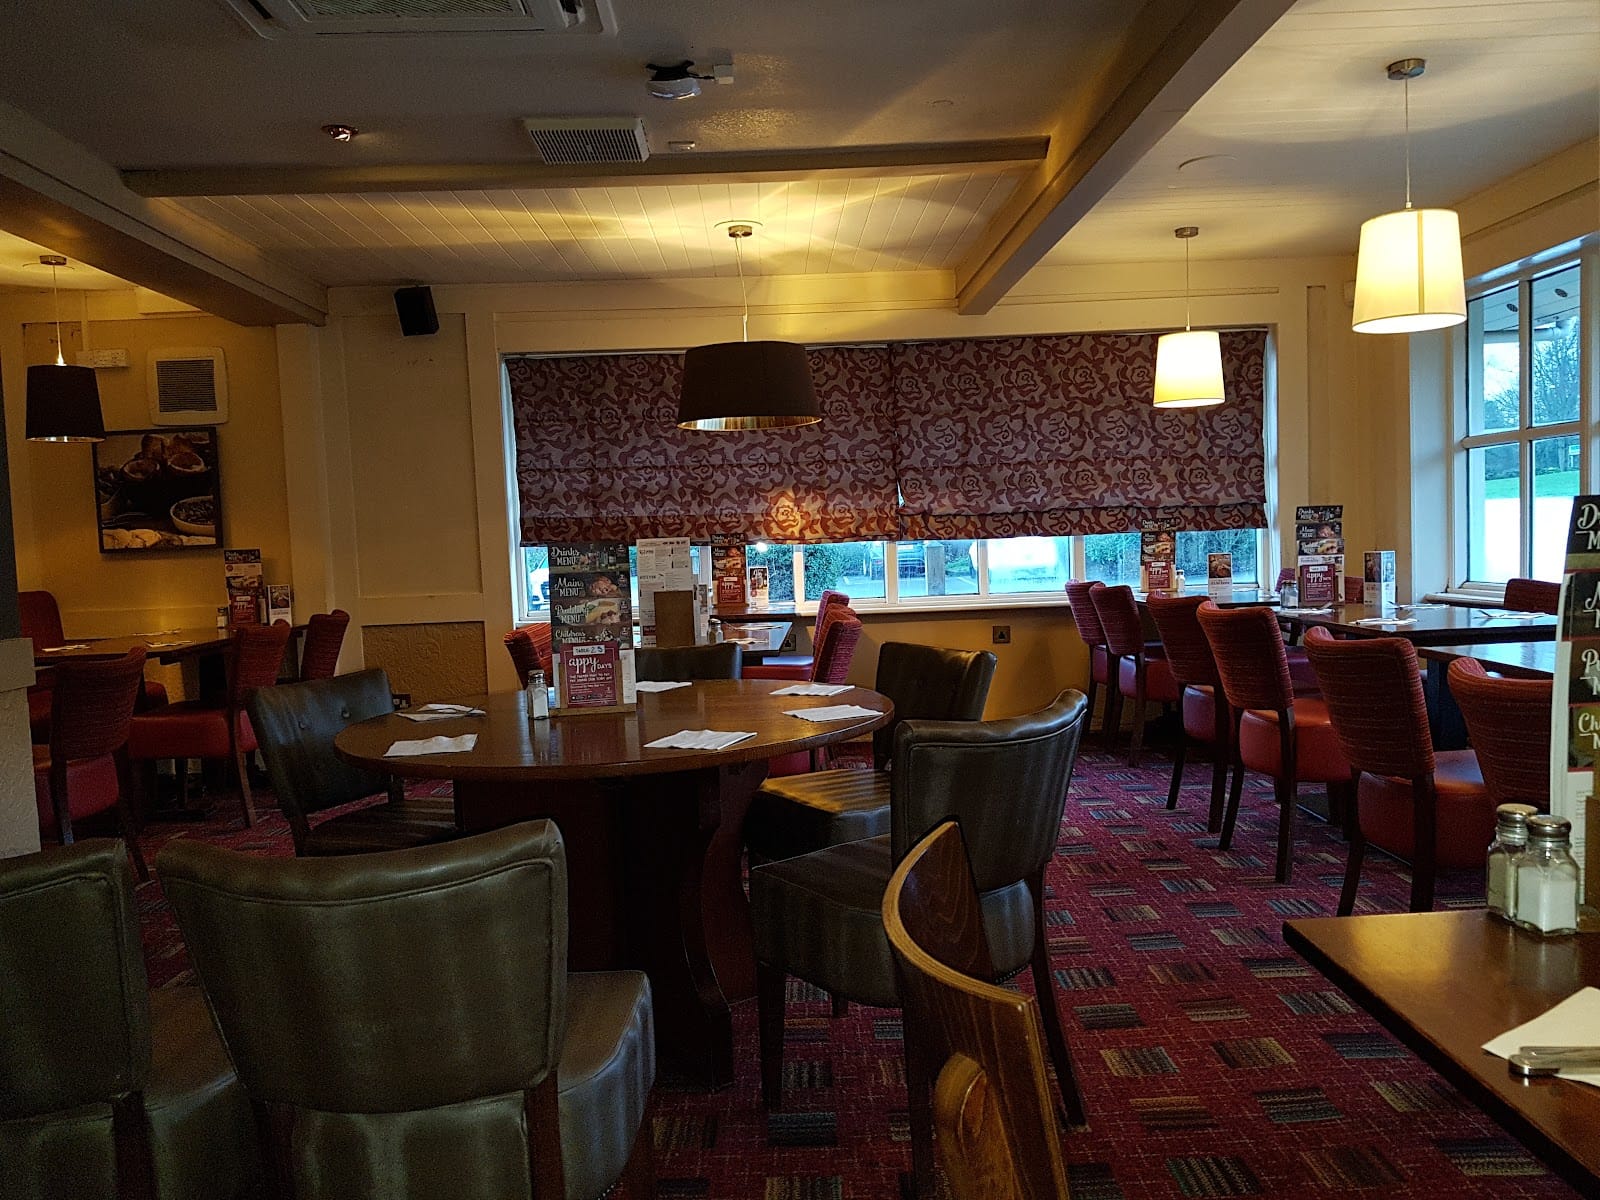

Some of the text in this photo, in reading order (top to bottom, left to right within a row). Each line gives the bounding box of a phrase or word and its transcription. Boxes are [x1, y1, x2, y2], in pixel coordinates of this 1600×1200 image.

[551, 546, 580, 557] Drinks
[557, 557, 576, 565] MENU
[559, 588, 579, 597] MENU
[561, 614, 580, 624] MENU
[569, 656, 598, 674] appy
